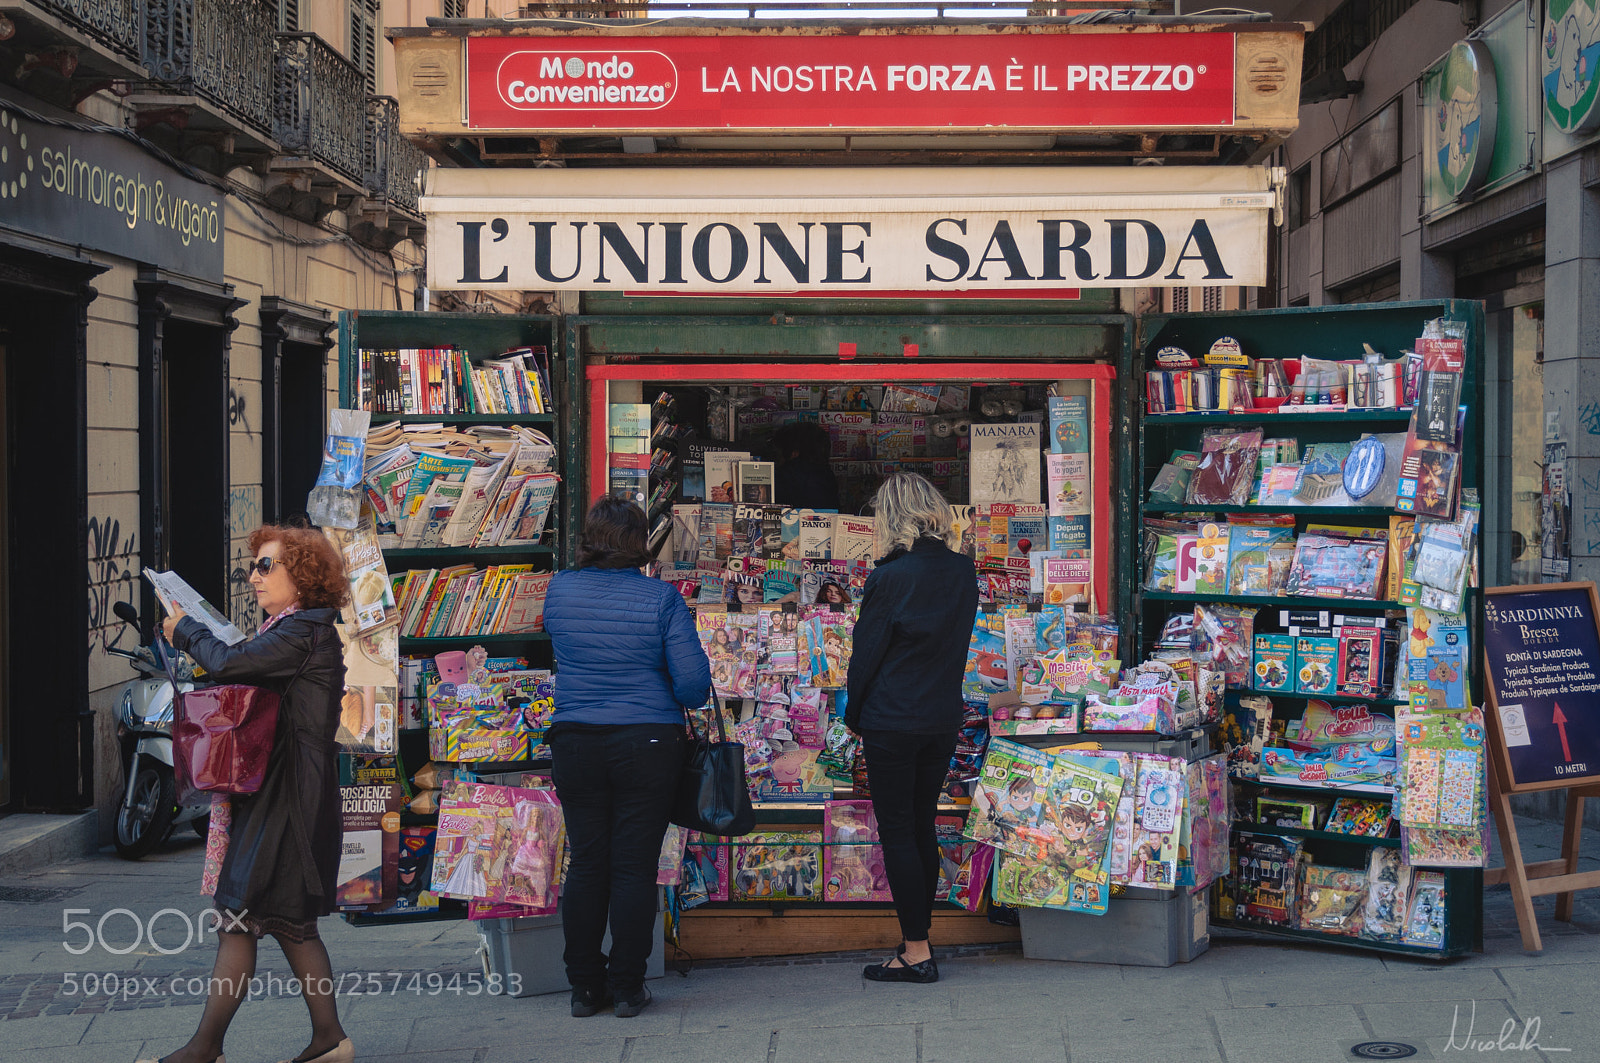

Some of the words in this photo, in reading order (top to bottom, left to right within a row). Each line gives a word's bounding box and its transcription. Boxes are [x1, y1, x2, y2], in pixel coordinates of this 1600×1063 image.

[539, 55, 634, 79] Mondo
[701, 66, 741, 93] LA
[751, 65, 877, 93] NOSTRA
[887, 64, 995, 92] FORZA
[1005, 58, 1023, 91] È
[1033, 65, 1057, 92] IL
[1067, 64, 1194, 92] PREZZO
[507, 80, 665, 103] Convenienza
[41, 144, 151, 229] salmoiraghi
[154, 179, 166, 229] &
[925, 218, 1233, 283] SARDA
[974, 426, 1036, 437] MANARA
[417, 462, 465, 473] ENIGMISTICA
[421, 455, 444, 466] ARTE
[1062, 466, 1082, 475] yogurt
[992, 505, 1015, 513] RIZA
[1056, 524, 1084, 532] Depura
[1061, 532, 1086, 540] fegato
[727, 570, 760, 587] VANITY
[699, 614, 727, 630] Pinky
[1443, 616, 1462, 627] Pooh
[1500, 605, 1583, 624] SARDINNYA
[1519, 624, 1559, 639] Bresca
[1505, 650, 1532, 662] BONTÀ
[1533, 650, 1541, 660] DI
[1543, 648, 1583, 660] SARDEGNA
[1048, 661, 1088, 676] Magiki
[1504, 666, 1528, 677] Typical
[1529, 664, 1561, 674] Sardinian
[1562, 661, 1589, 671] Products
[1503, 677, 1532, 688] Typische
[1533, 674, 1566, 684] Sardische
[1566, 672, 1595, 682] Produkte
[1118, 686, 1140, 696] PASTA
[1140, 684, 1169, 696] MAGICA
[1501, 688, 1528, 699] Produits
[1528, 686, 1559, 698] Typiques
[1559, 685, 1568, 694] de
[1336, 705, 1369, 723] BOLLE
[1325, 716, 1375, 736] GIGANTI
[987, 755, 1011, 769] BEN
[1554, 766, 1563, 775] 10
[1565, 763, 1587, 774] METRI
[1071, 774, 1097, 791] BEN
[472, 785, 508, 804] Barbie
[1069, 787, 1094, 805] 10
[342, 799, 387, 813] ICOLOGIA
[439, 814, 470, 830] Barbie
[506, 886, 529, 898] Barbie
[396, 898, 409, 908] DC
